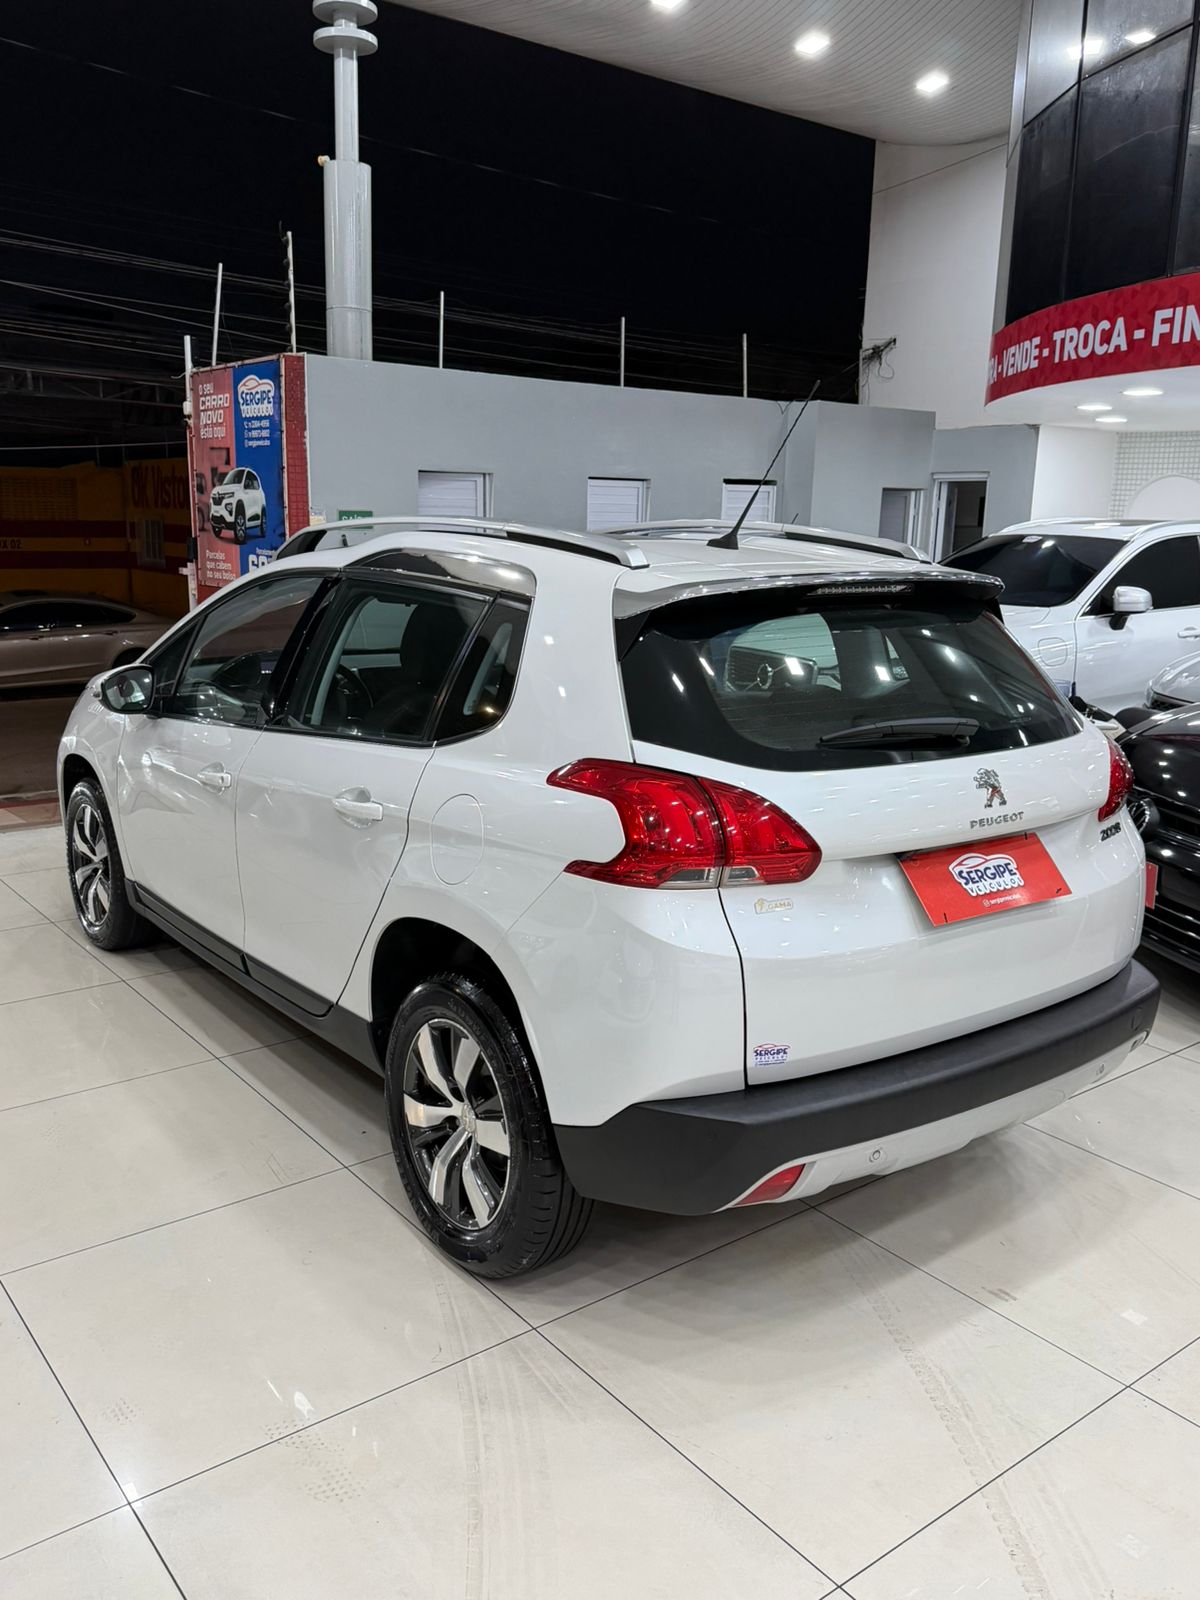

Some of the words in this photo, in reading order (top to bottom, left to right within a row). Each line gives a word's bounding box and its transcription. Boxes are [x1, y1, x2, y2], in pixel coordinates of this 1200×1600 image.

[1003, 336, 1041, 378] VENDE
[1053, 317, 1128, 363] TROCA
[200, 393, 230, 410] CARRO
[241, 389, 272, 406] SERGIPE
[200, 409, 224, 426] NOVO
[206, 549, 225, 560] Parcelas
[206, 561, 215, 570] que
[216, 561, 232, 570] cabem
[970, 811, 1025, 829] PEUGEOT
[957, 862, 1017, 886] SERGIPE
[767, 901, 792, 910] GAMA
[754, 1048, 788, 1057] SERGIPE
